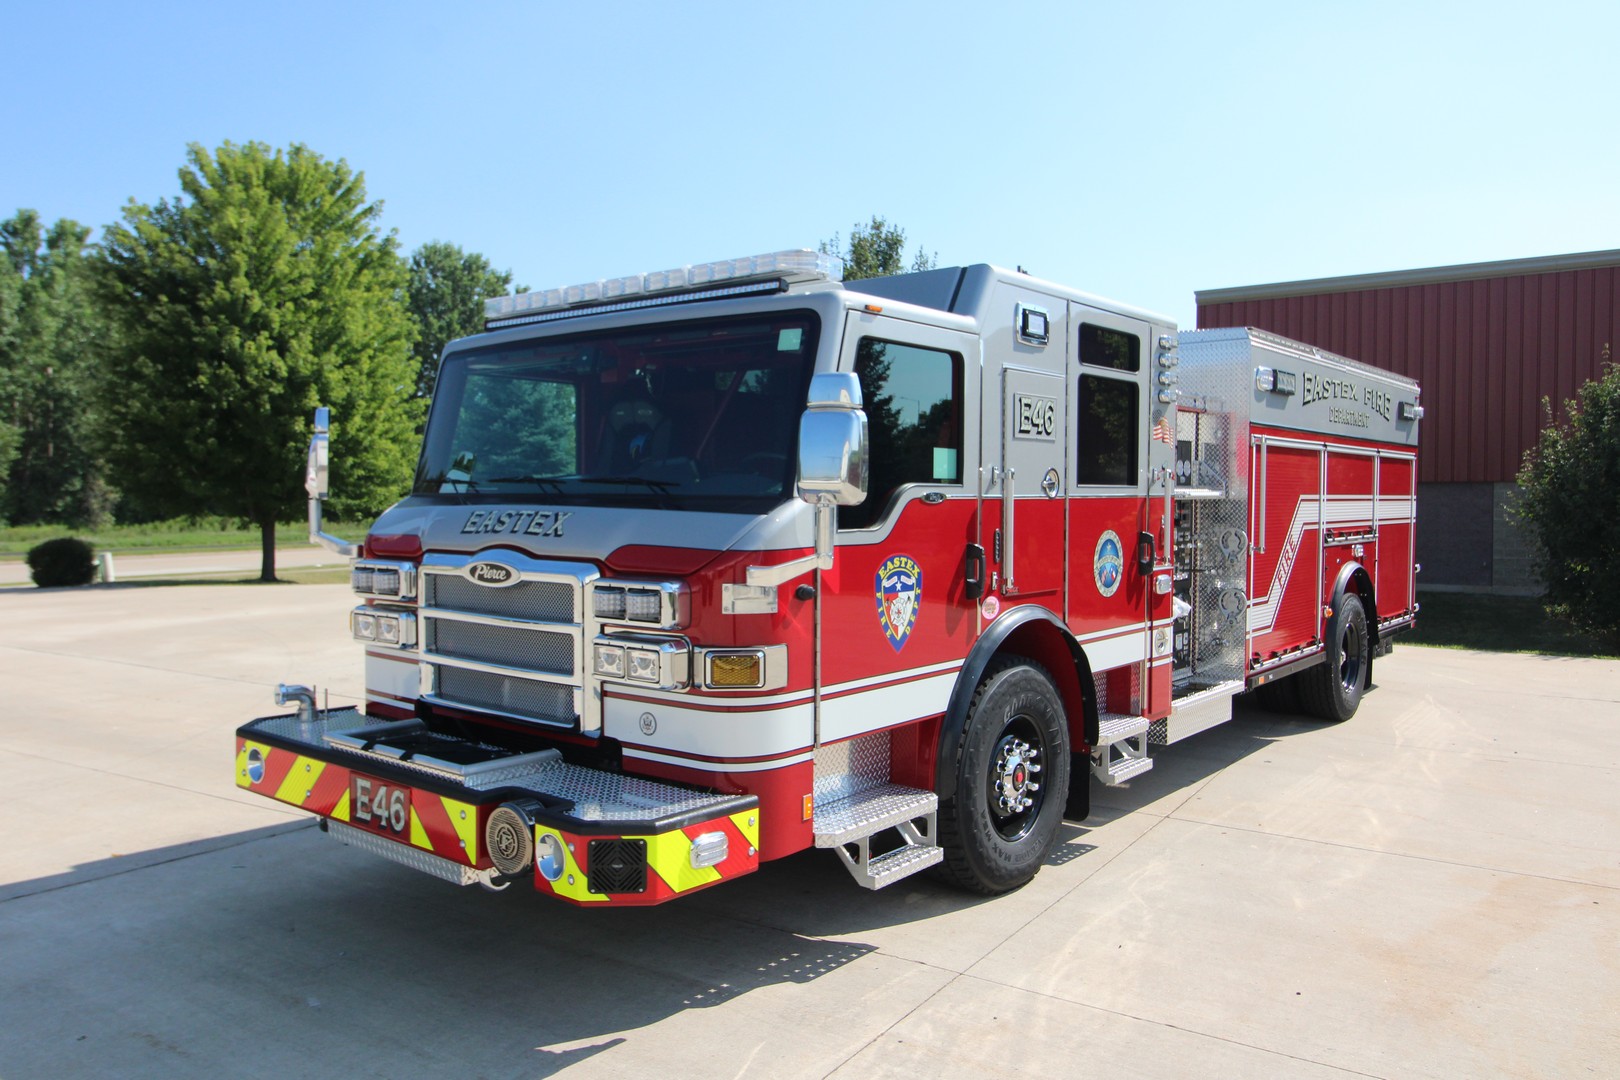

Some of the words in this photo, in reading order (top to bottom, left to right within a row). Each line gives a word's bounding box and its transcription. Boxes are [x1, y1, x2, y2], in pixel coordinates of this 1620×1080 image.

[1303, 371, 1358, 406] EASTEX
[1364, 387, 1391, 422] FIRE
[1019, 397, 1054, 436] E46
[1329, 406, 1370, 428] DEPARTMENT
[460, 510, 574, 537] EASTEX
[475, 564, 507, 580] Pierce
[878, 557, 920, 580] EASTEX
[1278, 534, 1297, 588] FIRE
[876, 591, 892, 638] FIRE
[356, 777, 405, 834] E46
